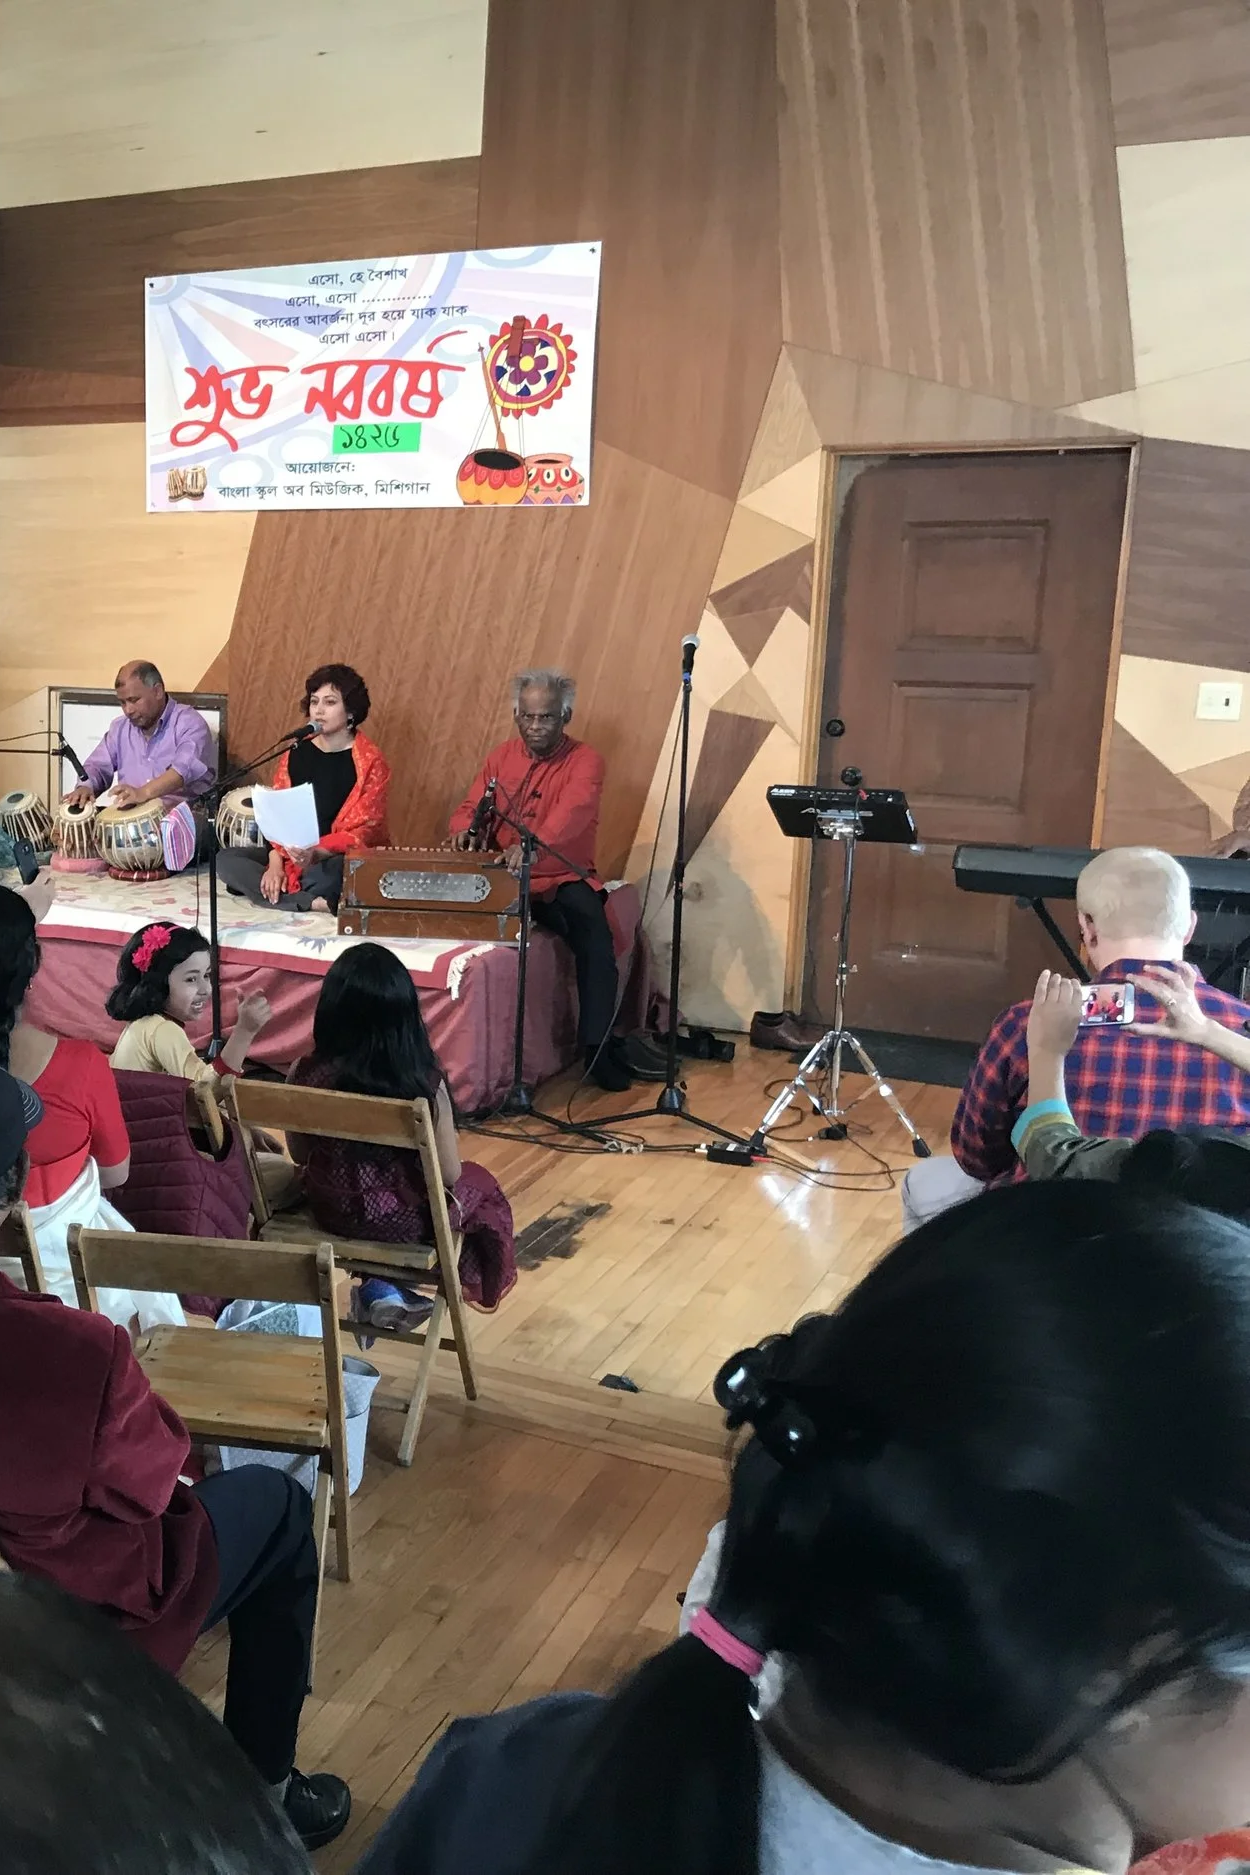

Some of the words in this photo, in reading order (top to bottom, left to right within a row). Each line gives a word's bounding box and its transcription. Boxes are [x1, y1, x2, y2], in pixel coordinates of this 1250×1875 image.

[349, 271, 365, 284] হে
[367, 267, 409, 281] বৈশাখ
[324, 292, 358, 305] এসো
[303, 309, 354, 327] আবর্জনা
[410, 307, 437, 320] যাক
[440, 304, 469, 317] যাক
[170, 364, 289, 452] শুভ
[301, 329, 467, 422] নববর্ষ
[217, 485, 251, 498] বাংলা
[255, 485, 278, 500] স্কুল
[283, 484, 305, 497] অব
[375, 478, 431, 495] মিশিগান
